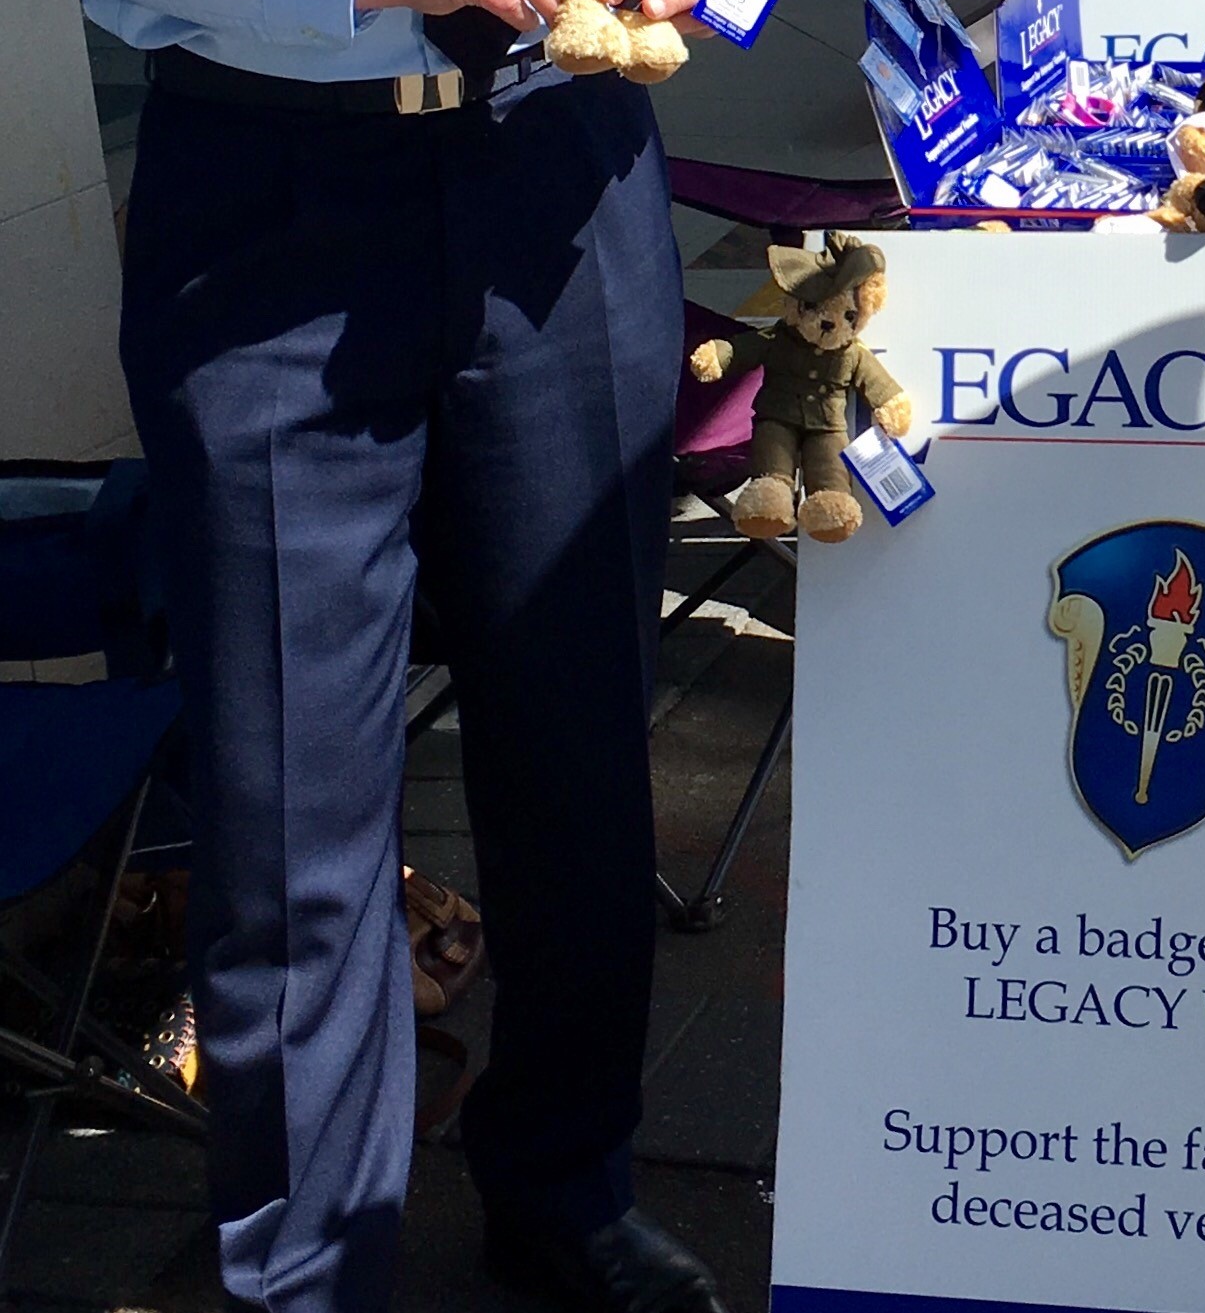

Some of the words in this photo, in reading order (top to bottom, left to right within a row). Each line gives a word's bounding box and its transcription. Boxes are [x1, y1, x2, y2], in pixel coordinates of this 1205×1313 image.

[1020, 6, 1061, 70] LEGACY
[914, 68, 961, 141] LEGACY
[929, 907, 1020, 966] Buy
[1036, 926, 1060, 954] a
[964, 977, 1187, 1030] LEGACY
[884, 1110, 1078, 1172] Support
[1093, 1122, 1167, 1168] the
[932, 1181, 1148, 1237] deceased
